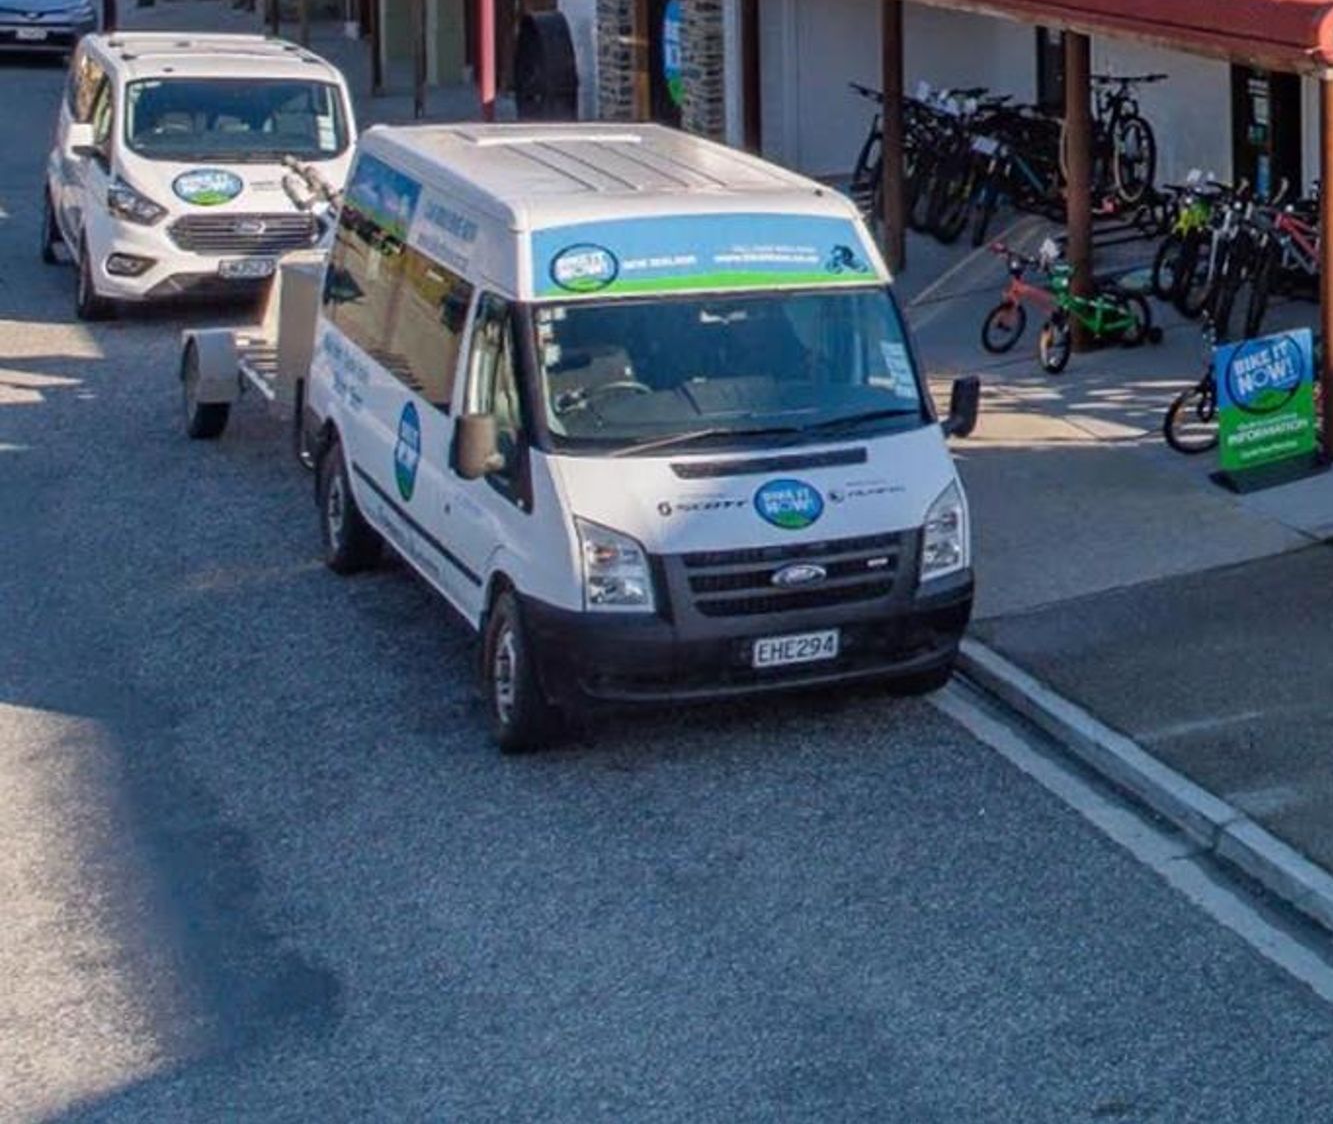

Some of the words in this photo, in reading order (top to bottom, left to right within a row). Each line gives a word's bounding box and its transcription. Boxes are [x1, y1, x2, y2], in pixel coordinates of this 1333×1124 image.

[1232, 349, 1271, 374] BIKE
[1272, 339, 1289, 360] IT
[1237, 356, 1296, 396] NOW!
[1227, 419, 1309, 447] INFORMATION
[757, 634, 837, 664] EHE294
